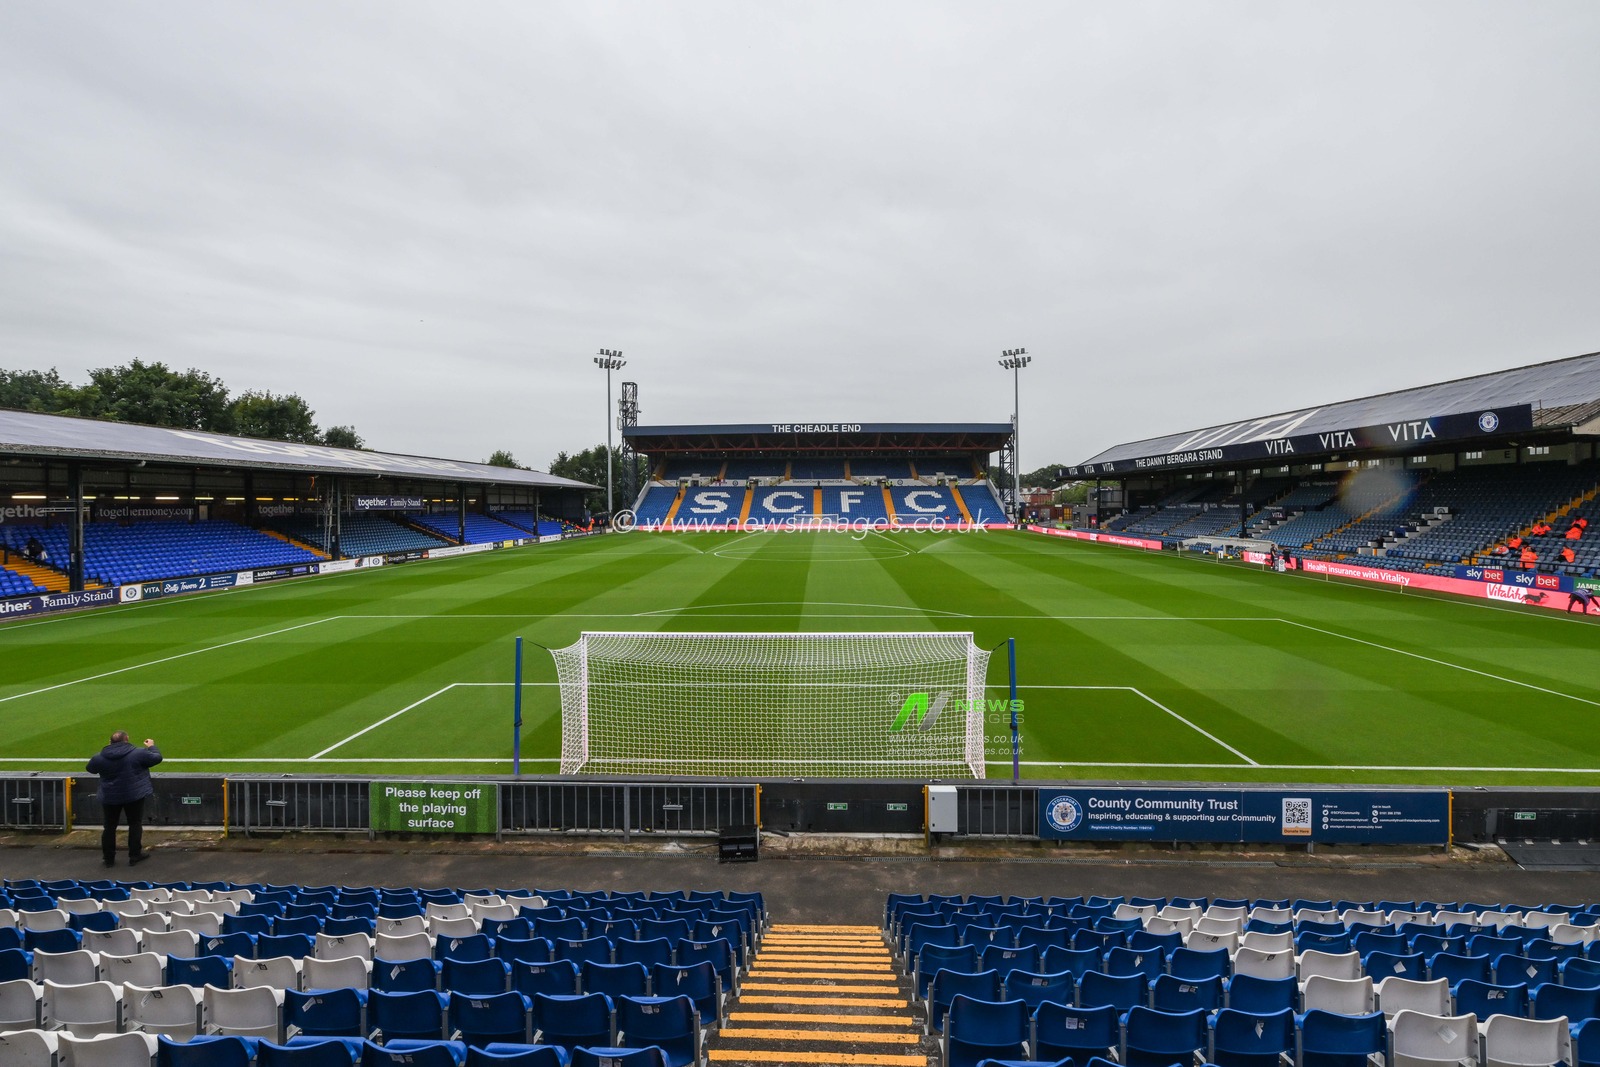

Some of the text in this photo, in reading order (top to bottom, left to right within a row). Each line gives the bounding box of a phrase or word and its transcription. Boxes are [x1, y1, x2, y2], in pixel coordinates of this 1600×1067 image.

[772, 424, 861, 432] THE CHEADLE END
[1388, 420, 1436, 442] VITA
[1320, 431, 1356, 449] VITA
[1265, 439, 1294, 454] VITA
[1136, 449, 1223, 468] THE DANNY BERGARA STAND
[1504, 450, 1510, 458] E
[1084, 466, 1095, 474] VITA
[1102, 463, 1114, 472] VITA
[390, 498, 407, 508] Family
[408, 498, 421, 506] Stand
[1307, 562, 1410, 585] Health insurance with Vitality
[1466, 568, 1501, 580] sky bet
[199, 578, 206, 589] 2
[1516, 574, 1556, 586] sky bet
[42, 593, 81, 607] Family
[83, 590, 113, 602] Stand
[1488, 584, 1526, 604] Vitality
[385, 787, 481, 800] Please keep off
[1052, 798, 1077, 806] STOCKPORT
[1088, 797, 1238, 812] County Community Trust
[399, 803, 466, 816] the playing
[408, 818, 454, 828] surface
[1088, 812, 1123, 821] Inspiring,
[1125, 813, 1163, 822] educating
[1173, 814, 1215, 823] supporting
[1231, 815, 1276, 824] Community
